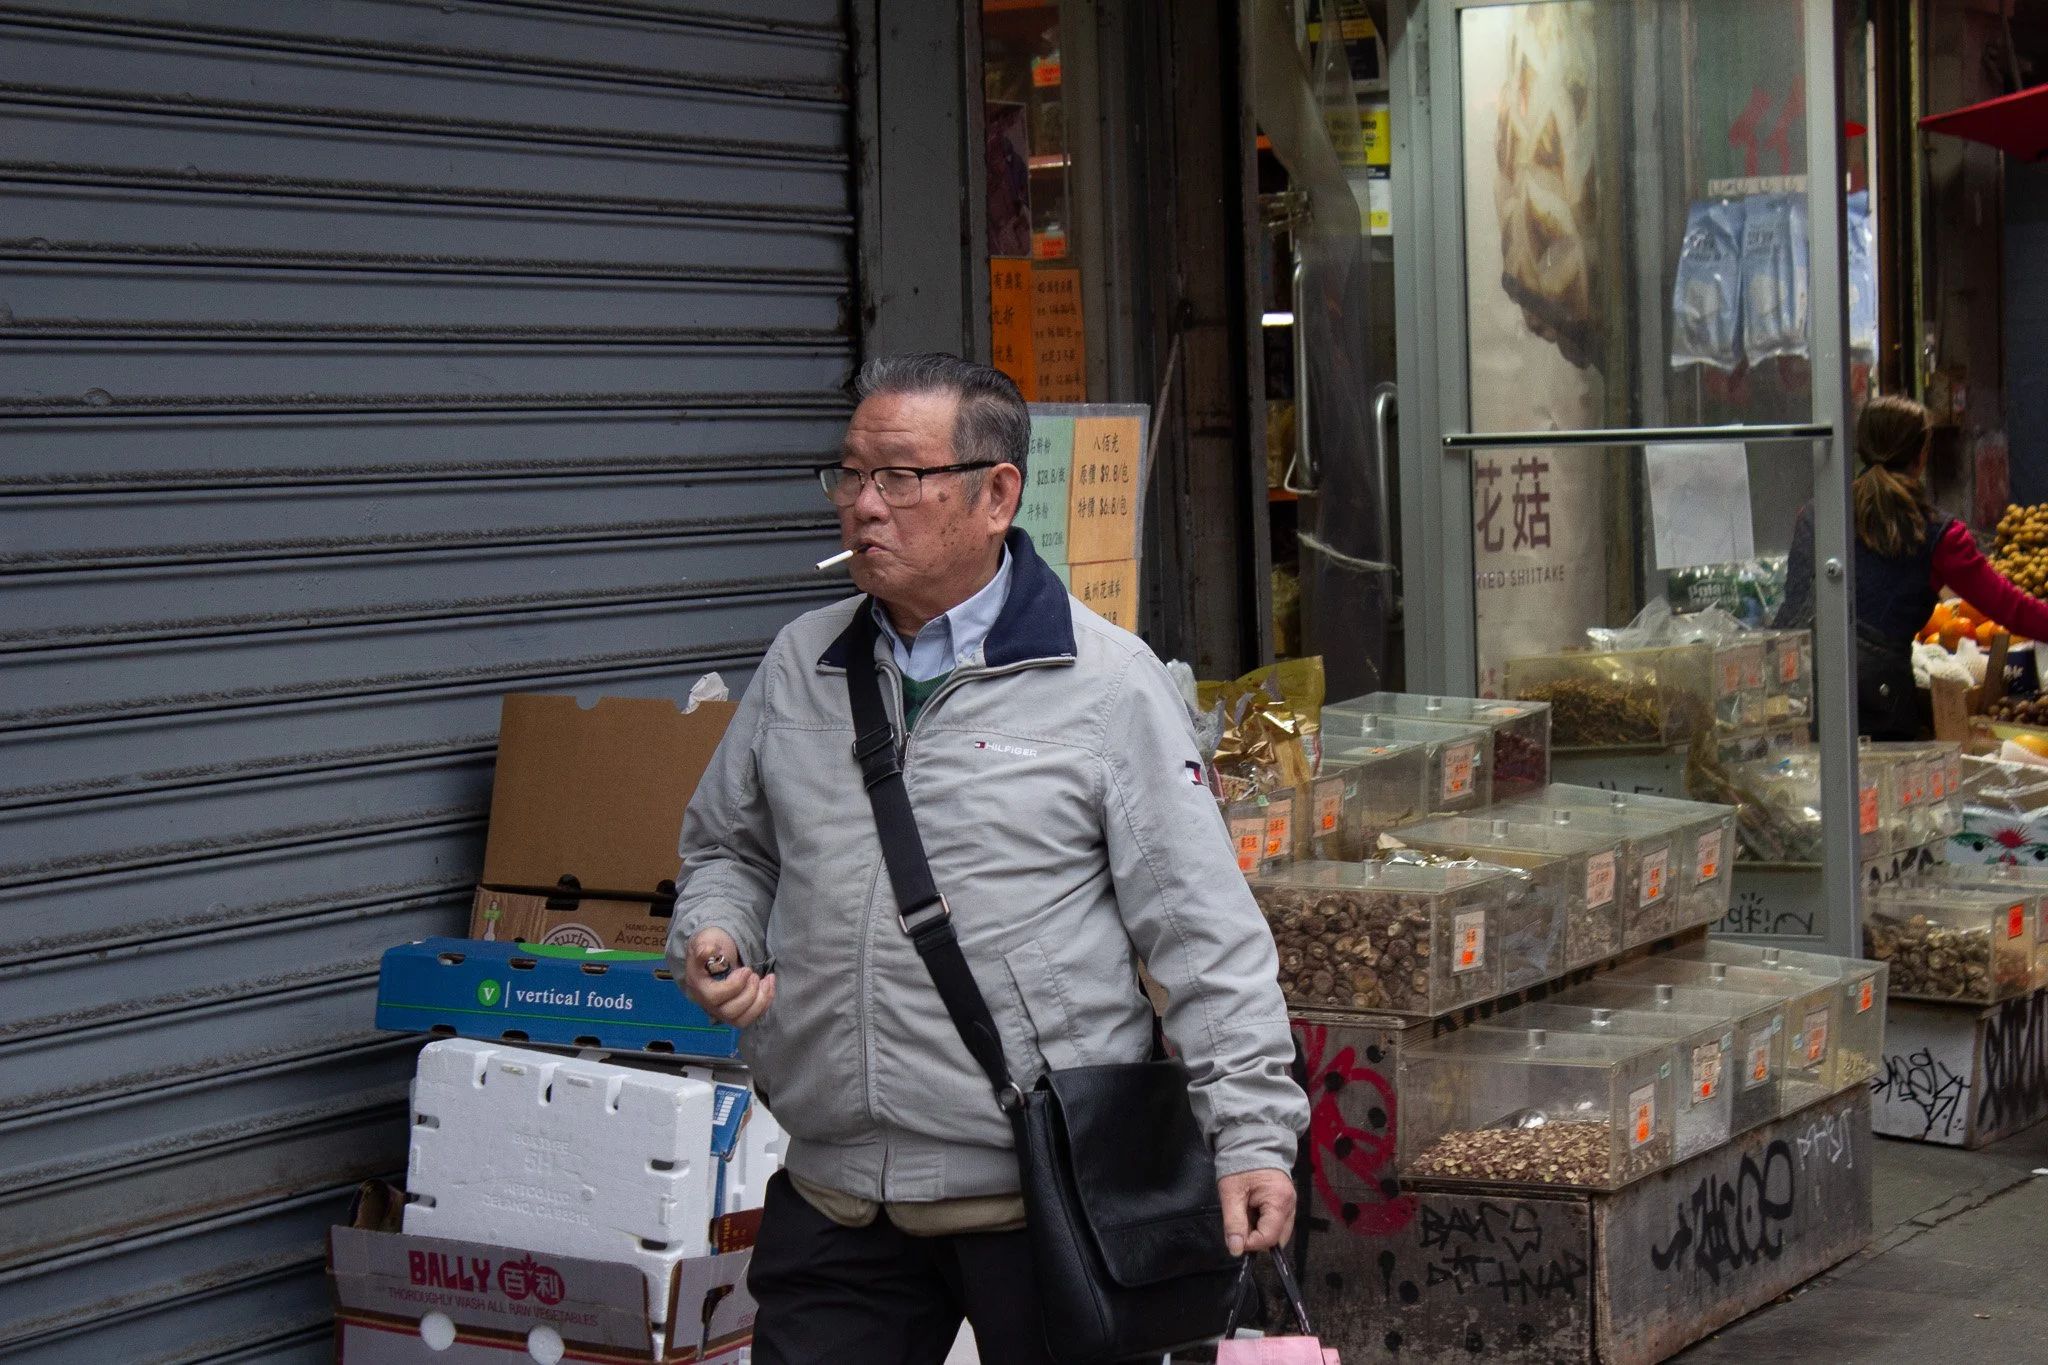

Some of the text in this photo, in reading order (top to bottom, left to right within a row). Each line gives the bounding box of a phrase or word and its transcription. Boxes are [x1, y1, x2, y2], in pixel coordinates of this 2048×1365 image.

[1510, 565, 1565, 587] SHIITAKE
[984, 742, 1038, 758] HILFIGER
[549, 932, 595, 950] turip
[516, 988, 580, 1006] vertical
[586, 992, 633, 1010] foods
[408, 1250, 490, 1293] BALLY
[503, 1267, 560, 1300] 百利
[387, 1286, 599, 1327] THOROUGHLY WASH ALL RAW VEGETABLES
